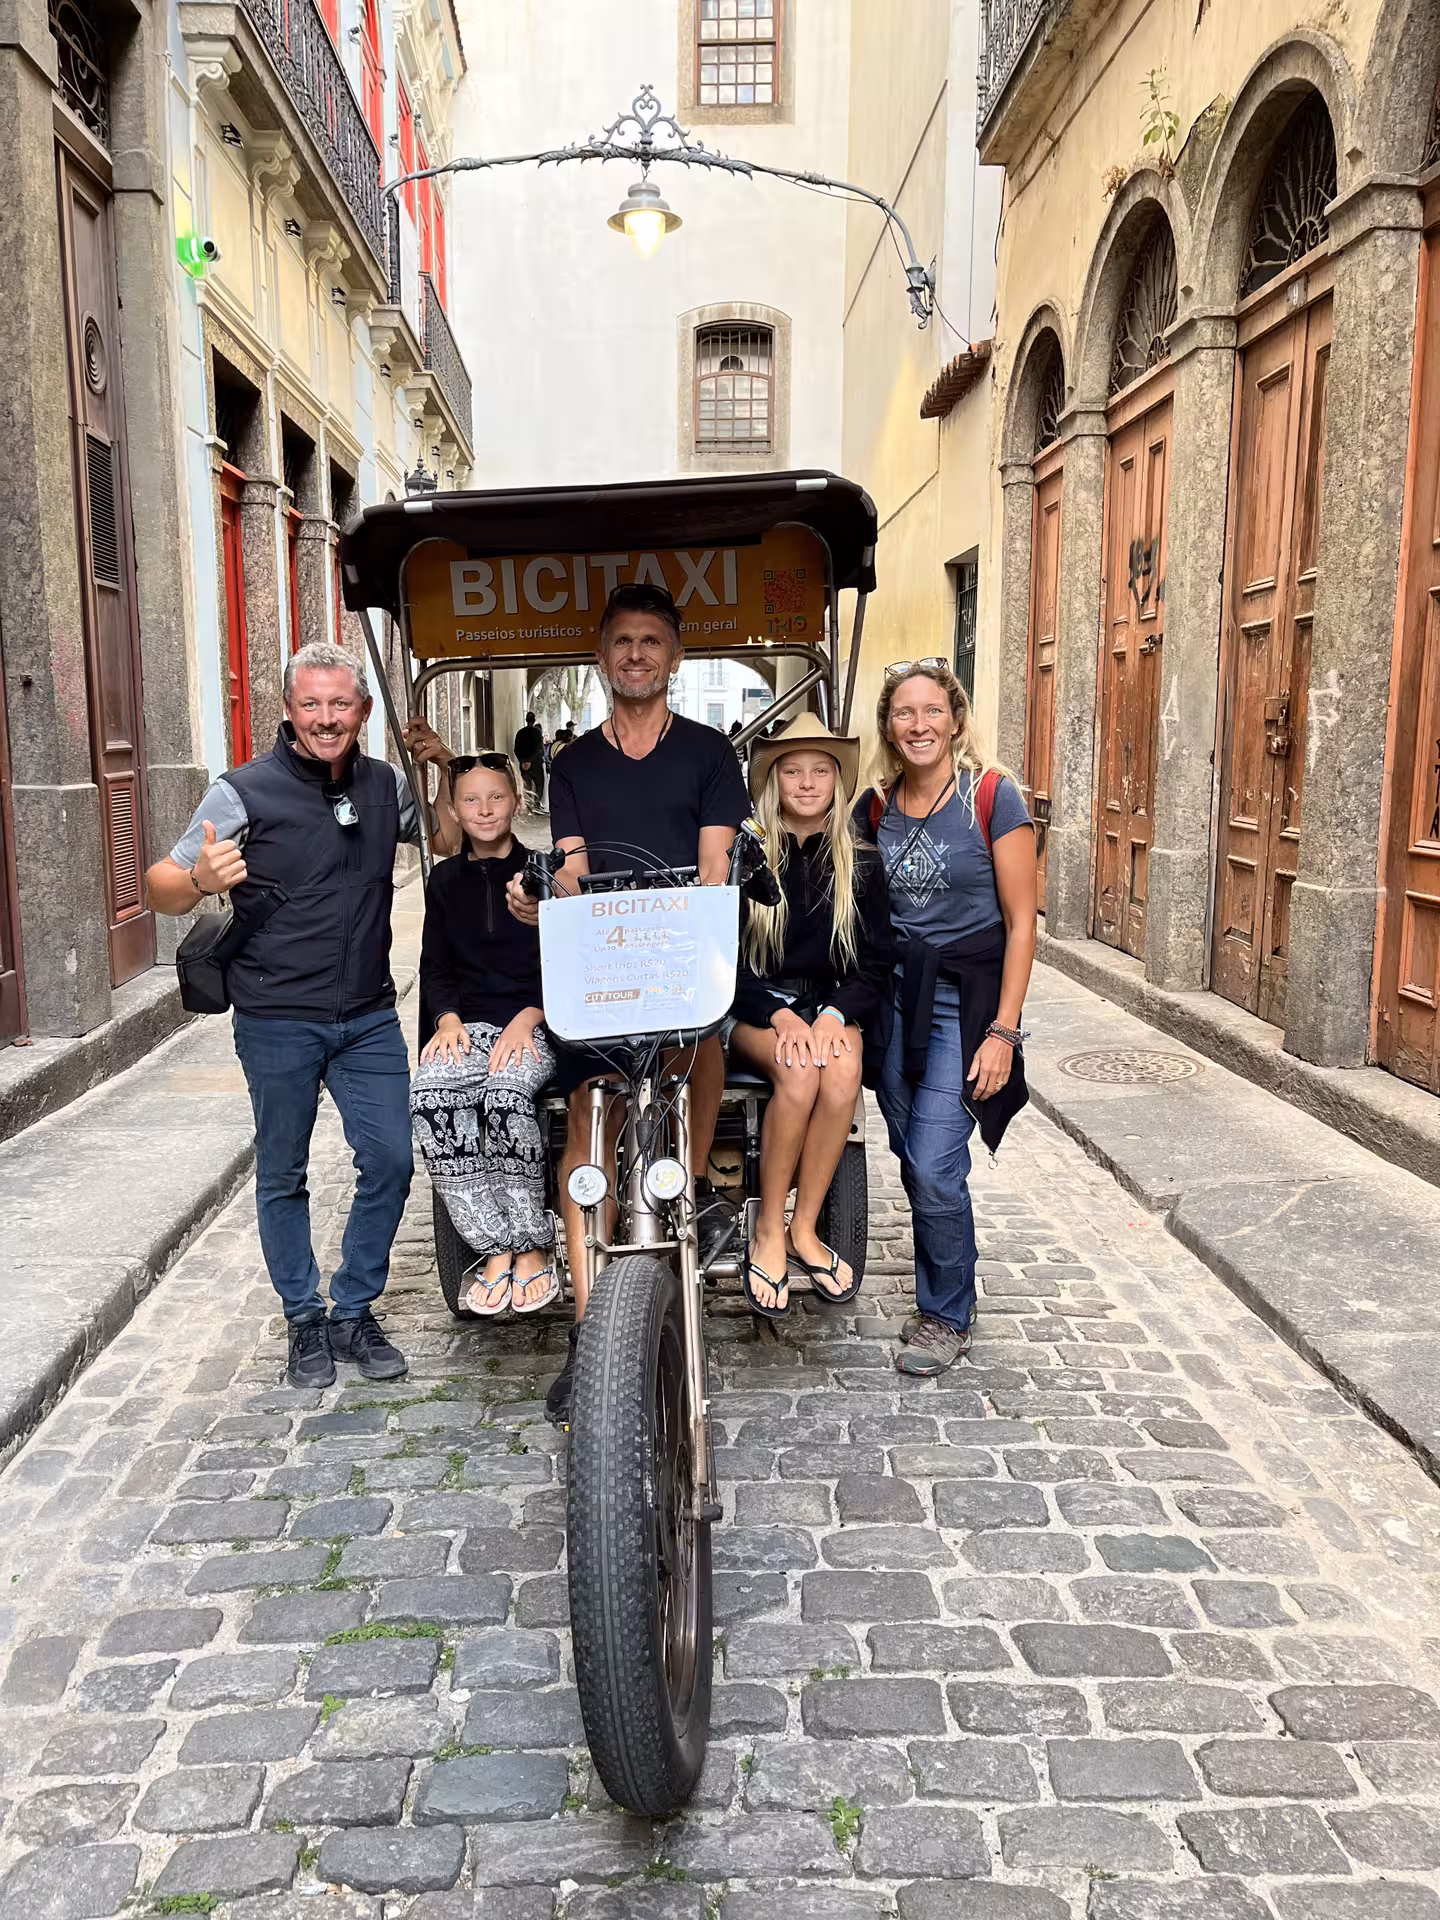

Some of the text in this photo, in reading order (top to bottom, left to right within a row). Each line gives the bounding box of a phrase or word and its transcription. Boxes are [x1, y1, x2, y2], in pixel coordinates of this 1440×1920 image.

[450, 550, 738, 617] BICITAXI
[455, 627, 516, 641] Passeios
[703, 617, 737, 633] geral
[591, 895, 689, 917] BICITAXI
[605, 925, 626, 947] 4
[584, 963, 612, 973] Short
[585, 991, 633, 1002] CITY TOUR
